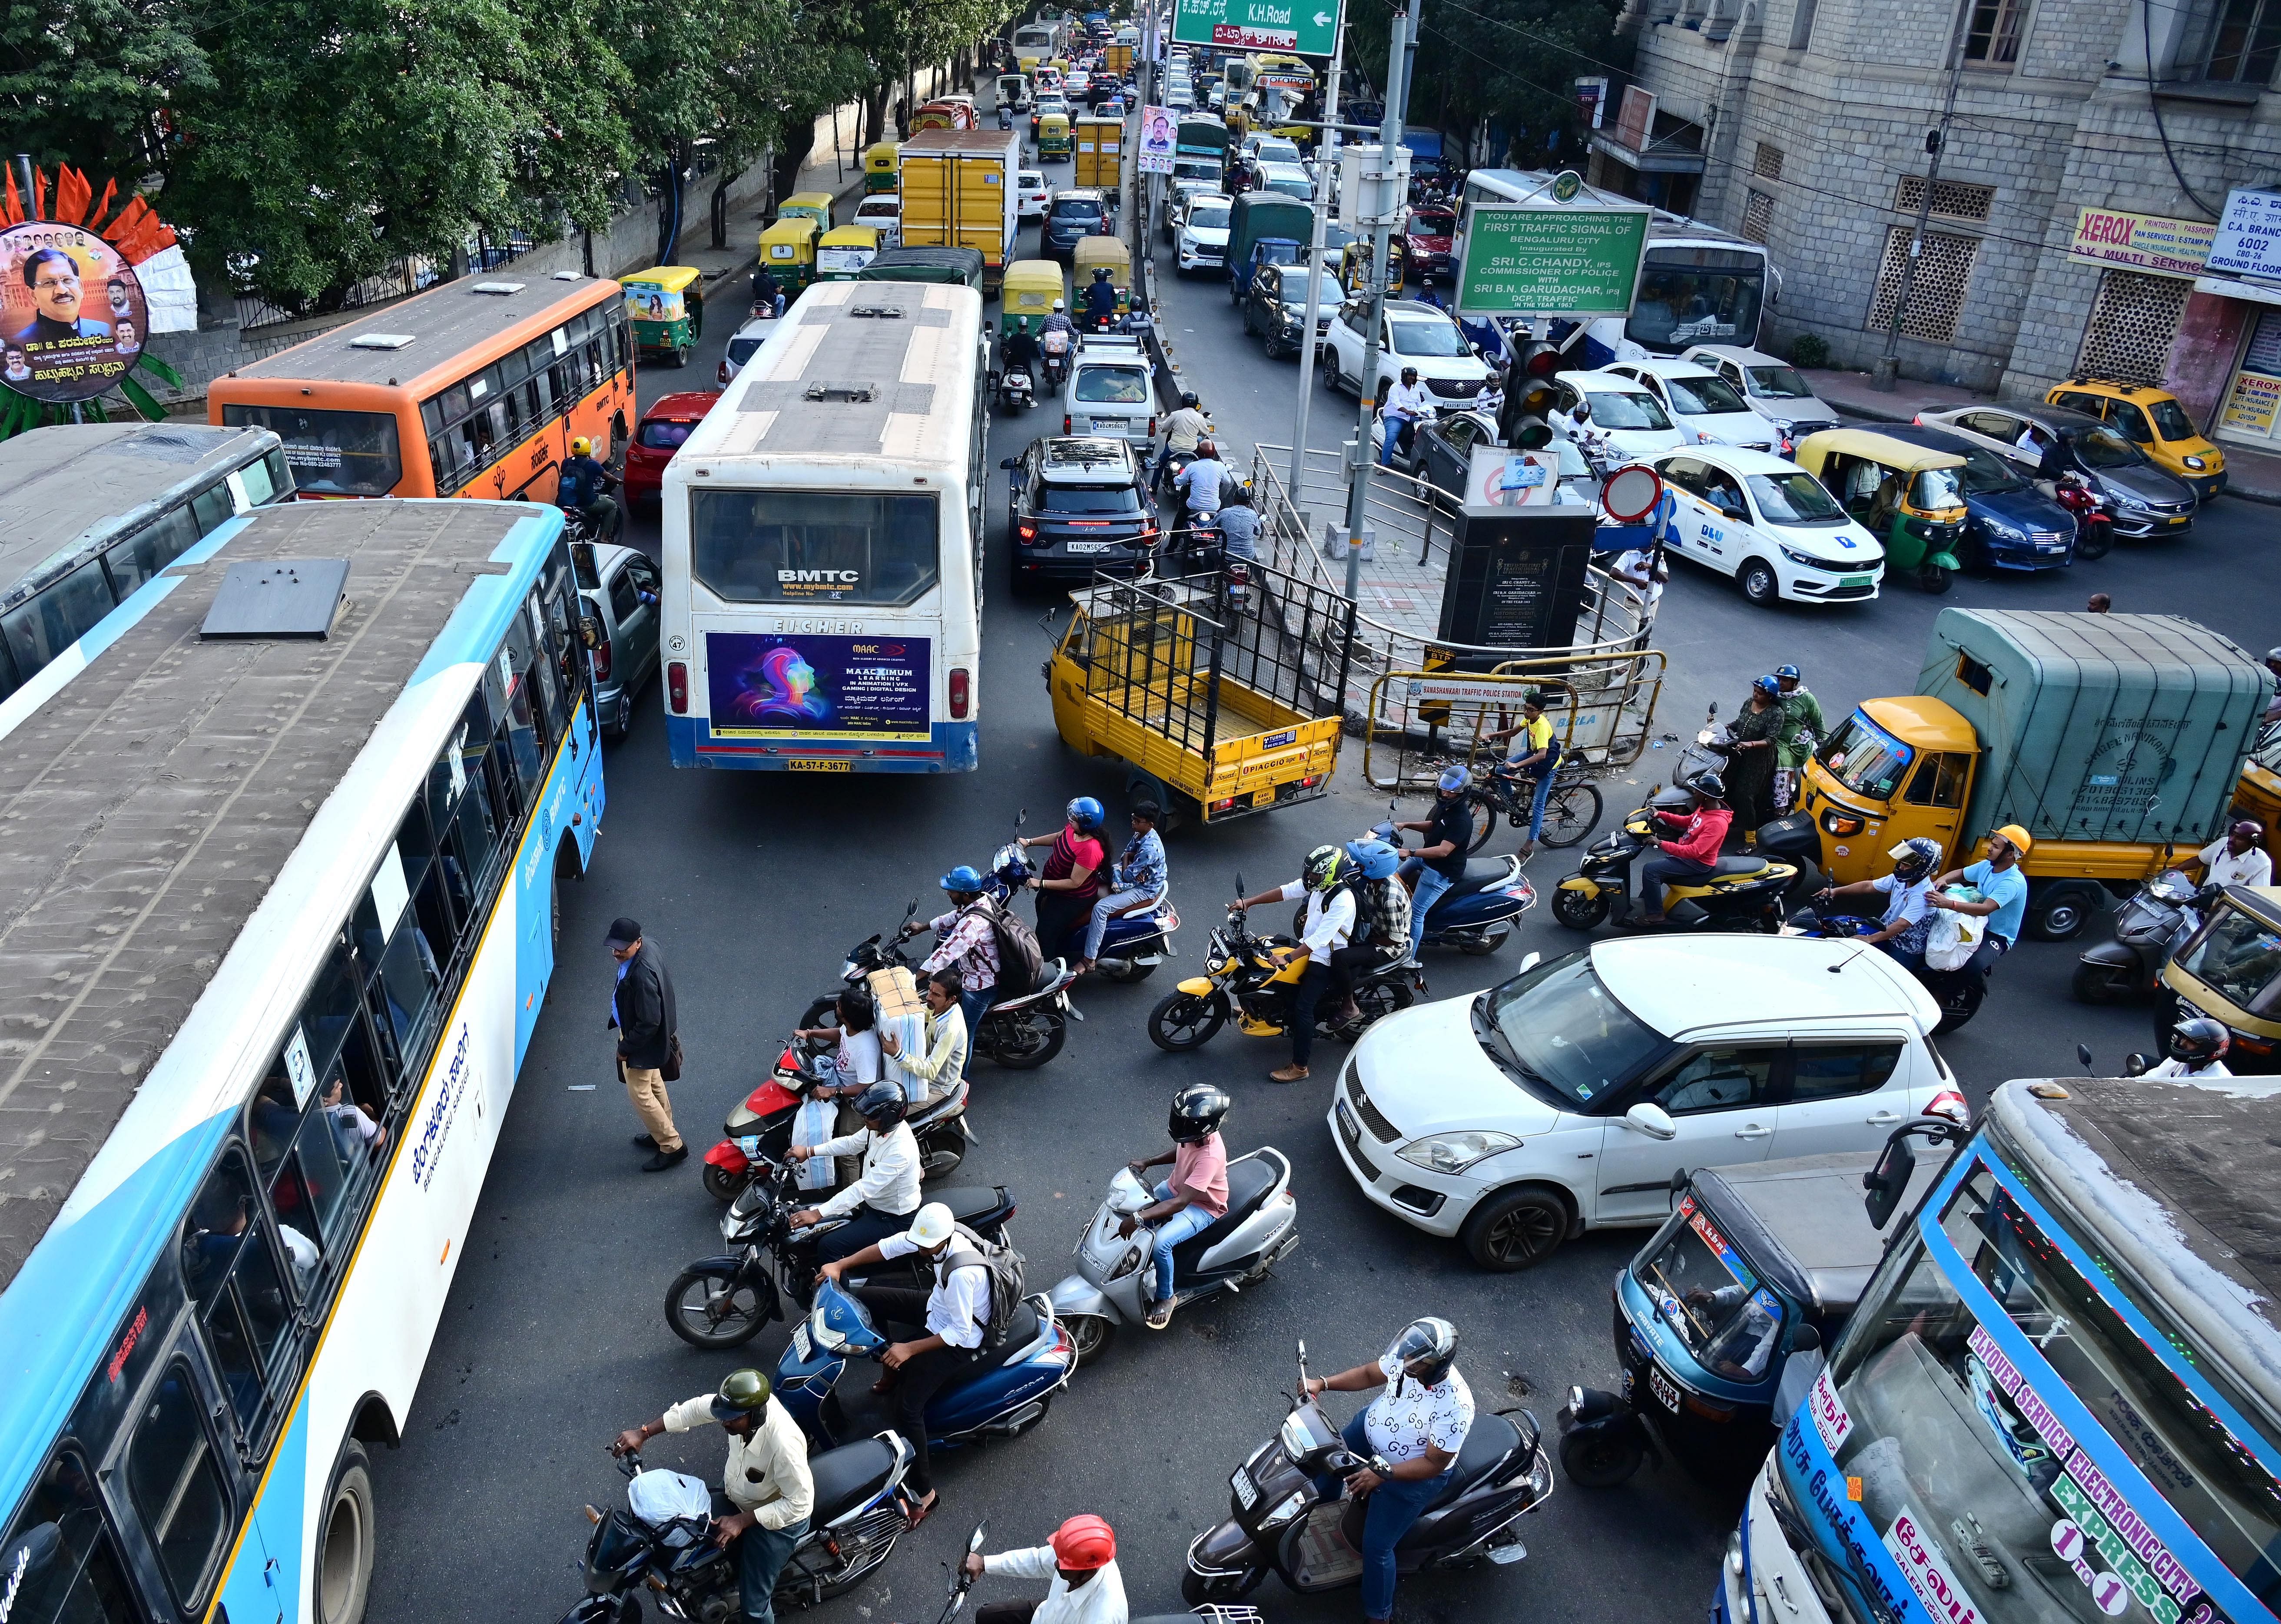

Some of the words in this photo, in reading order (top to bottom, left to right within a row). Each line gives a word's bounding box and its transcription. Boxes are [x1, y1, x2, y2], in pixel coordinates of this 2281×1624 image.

[1248, 3, 1290, 24] K.H.Road
[1270, 75, 1311, 86] orange
[1535, 214, 1610, 223] APPROACHING
[1484, 223, 1517, 232] FIRST
[1520, 223, 1567, 233] TRAFFIC
[1570, 225, 1612, 235] SIGNAL
[1615, 226, 1631, 235] OF
[2079, 213, 2136, 246] XEROX
[2144, 219, 2177, 230] PRINTOUTS
[2184, 225, 2215, 236] PASSPORT
[2228, 222, 2245, 232] C.A.
[1510, 235, 1575, 244] BENGALURU
[2146, 232, 2174, 242] SERVICES
[2178, 236, 2203, 246] E-STAMP
[2238, 237, 2269, 251] 6002
[2074, 245, 2095, 257] S.V.
[2104, 249, 2144, 263] MULTI
[2132, 241, 2149, 250] VEHICLE
[2151, 243, 2175, 253] INSURANCE
[2178, 247, 2196, 256] HEALTH
[1491, 257, 1515, 266] SRI
[1518, 257, 1593, 268] C.CHANDY,
[2211, 256, 2249, 269] GROUND
[1480, 267, 1561, 275] COMMISSIONER
[1474, 284, 1492, 293] SRI
[1495, 285, 1517, 293] B.N.
[1520, 285, 1603, 296] GARUDACHAR,
[2240, 377, 2281, 391] XEROX
[596, 395, 609, 412] BMTC
[2245, 397, 2270, 406] INSURANCE
[2237, 413, 2257, 421] ADVISOR
[2246, 405, 2271, 416] INSURANCE
[1701, 524, 1724, 543] BLU
[778, 570, 859, 582] BMTC
[772, 619, 863, 634] EICHER
[852, 644, 880, 654] MAAC
[1431, 653, 1451, 662] BTP
[846, 668, 912, 676] MAACXIMUM
[1423, 686, 1461, 695] BANASHANKARI
[1462, 688, 1482, 696] TRAFFIC
[1483, 689, 1501, 697] POLICE
[1502, 690, 1522, 699] STATION
[1269, 733, 1286, 741] TURNO
[789, 760, 849, 771] KA-57-F-3677
[1250, 759, 1284, 772] PIAGGIO
[550, 776, 566, 826] BMTC
[413, 1078, 449, 1184] ಬೆಂಗಳೂರು
[449, 1021, 469, 1089] ಸಾರಿಗೆ
[423, 1115, 453, 1193] BENGALURU
[453, 1064, 470, 1114] SARIGE
[1696, 1215, 1729, 1256] Akbar
[1637, 1310, 1664, 1347] PRIVATE
[1652, 1369, 1677, 1399] KA03
[1969, 1326, 2022, 1395] FLYOVER
[2016, 1387, 2073, 1458] SERVICE
[2067, 1449, 2158, 1561] ELECTRONIC
[2154, 1553, 2200, 1604] CITY
[2050, 1472, 2182, 1624] EXPRESS
[1893, 1551, 1924, 1597] SALEM
[2053, 1525, 2078, 1557] 1
[2074, 1558, 2093, 1584] TO
[2096, 1579, 2122, 1612] 1
